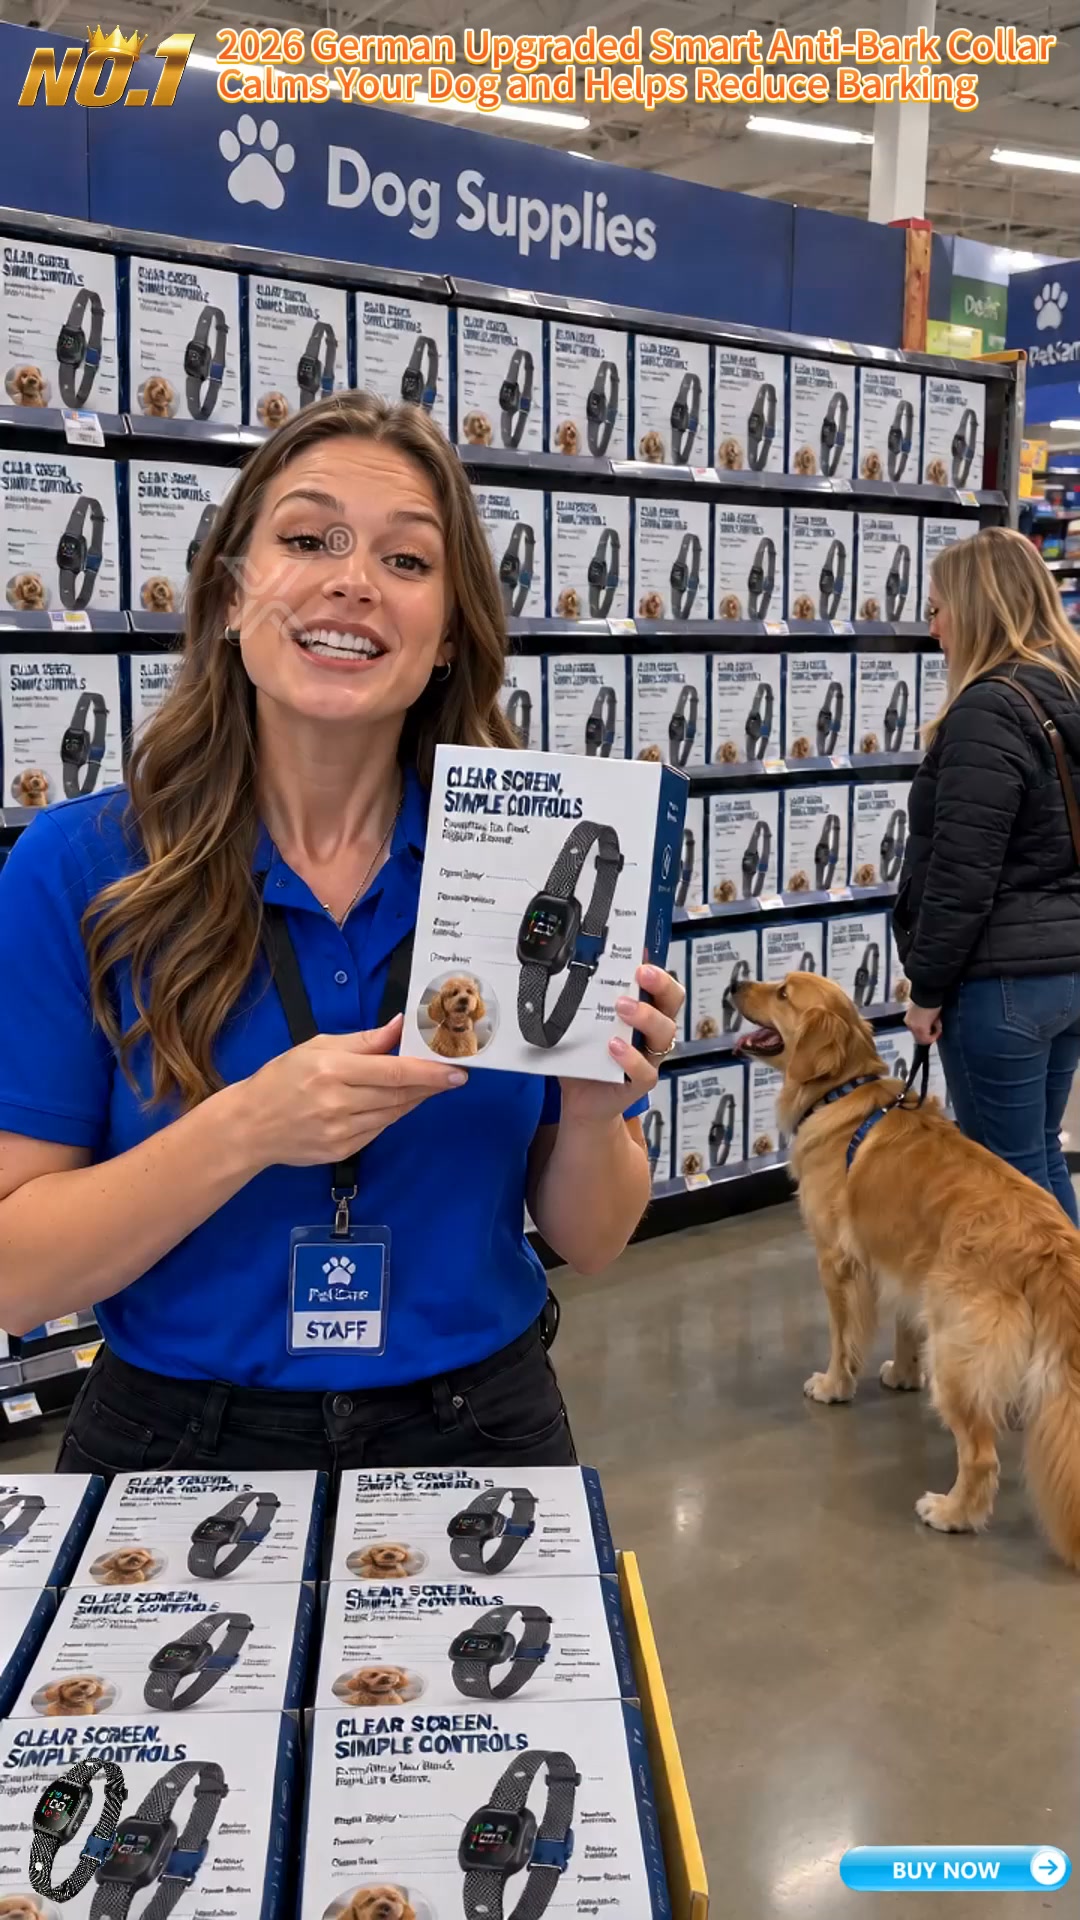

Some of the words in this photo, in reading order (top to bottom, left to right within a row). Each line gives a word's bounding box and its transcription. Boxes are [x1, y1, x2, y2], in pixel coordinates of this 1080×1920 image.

[327, 145, 441, 240] Dog
[456, 170, 658, 262] Supplies
[306, 1320, 368, 1341] STAFF
[14, 1727, 78, 1747] CLEAR
[336, 1716, 405, 1738] CLEAR
[335, 1736, 414, 1759] SIMPLE
[418, 1733, 529, 1754] CONTROLS
[3, 1746, 84, 1769] SIMPLE
